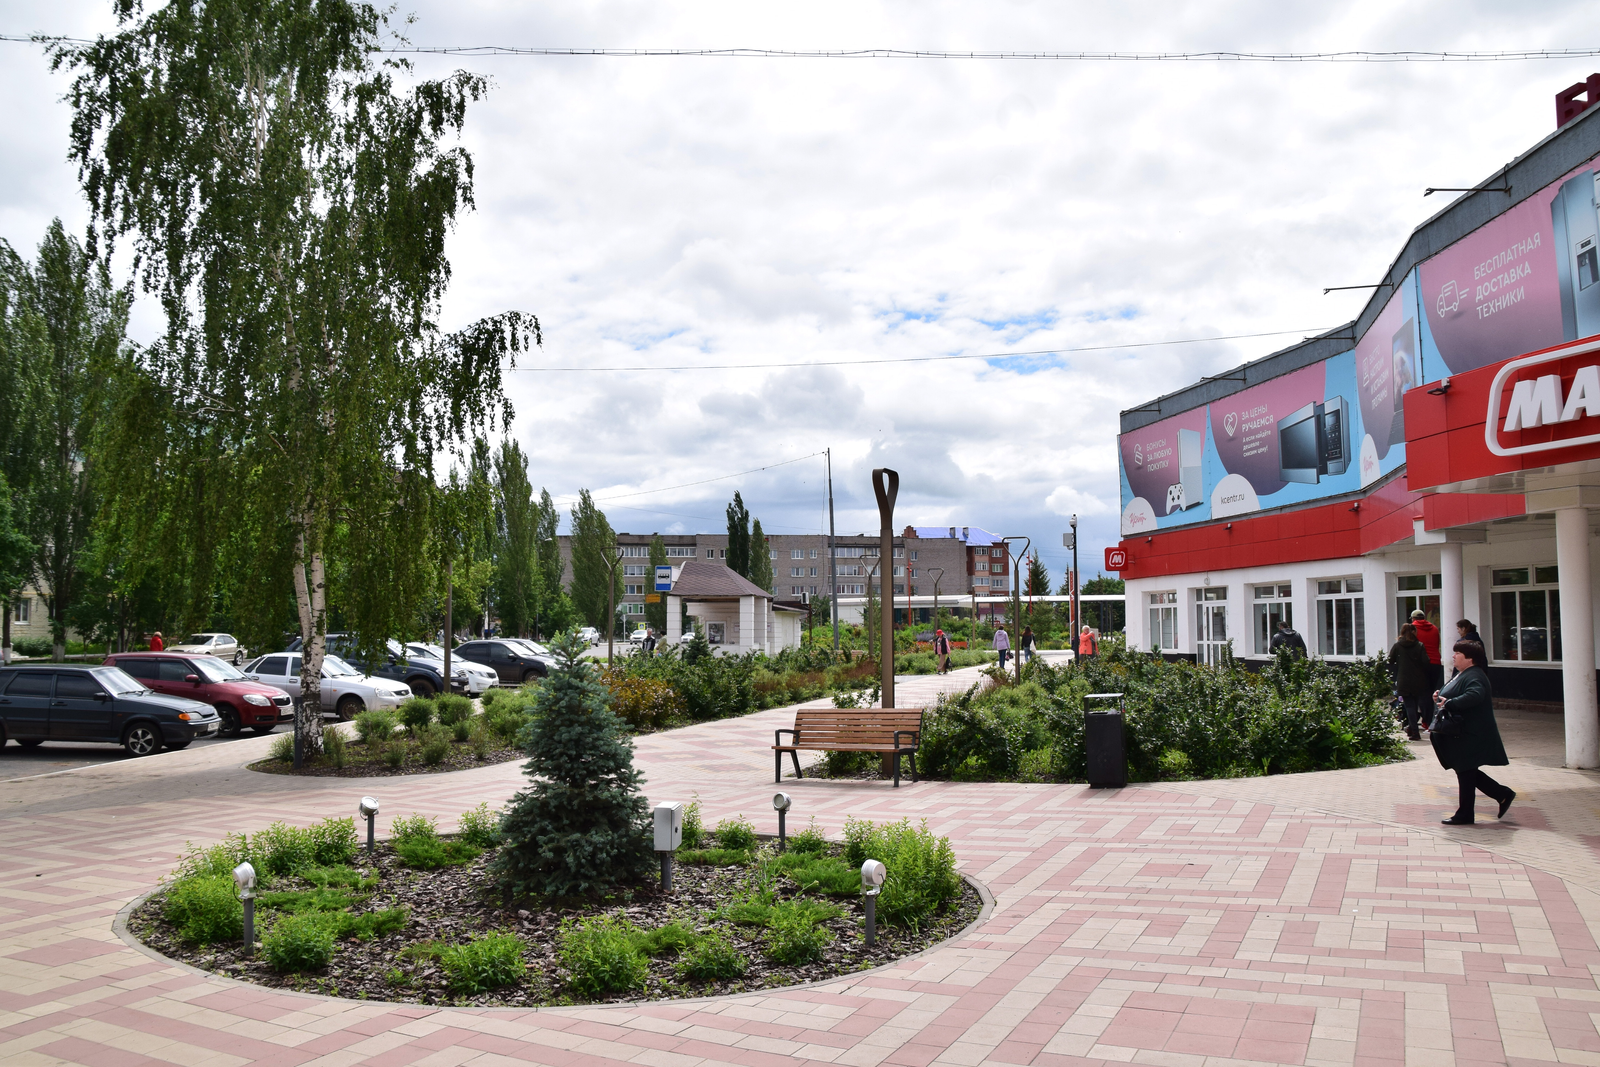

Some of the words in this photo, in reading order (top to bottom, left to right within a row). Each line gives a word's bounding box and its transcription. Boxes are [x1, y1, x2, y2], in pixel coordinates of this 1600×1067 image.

[1474, 232, 1541, 280] БЕСПЛАТНАЯ
[1476, 261, 1531, 303] ДОСТАВКА
[1476, 286, 1524, 320] ТЕХНИКИ
[1503, 365, 1600, 432] МА
[1241, 411, 1249, 421] ЗА
[1250, 404, 1268, 418] ЦЕНЫ
[1242, 415, 1274, 432] РУЧАЕМСЯ
[1146, 438, 1167, 451] БОНУСЫ
[1147, 453, 1153, 462] ЗА
[1153, 447, 1172, 460] ЛЮБУЮ
[1147, 460, 1169, 472] ПОКУПКУ
[1220, 493, 1245, 505] kcentr.ru
